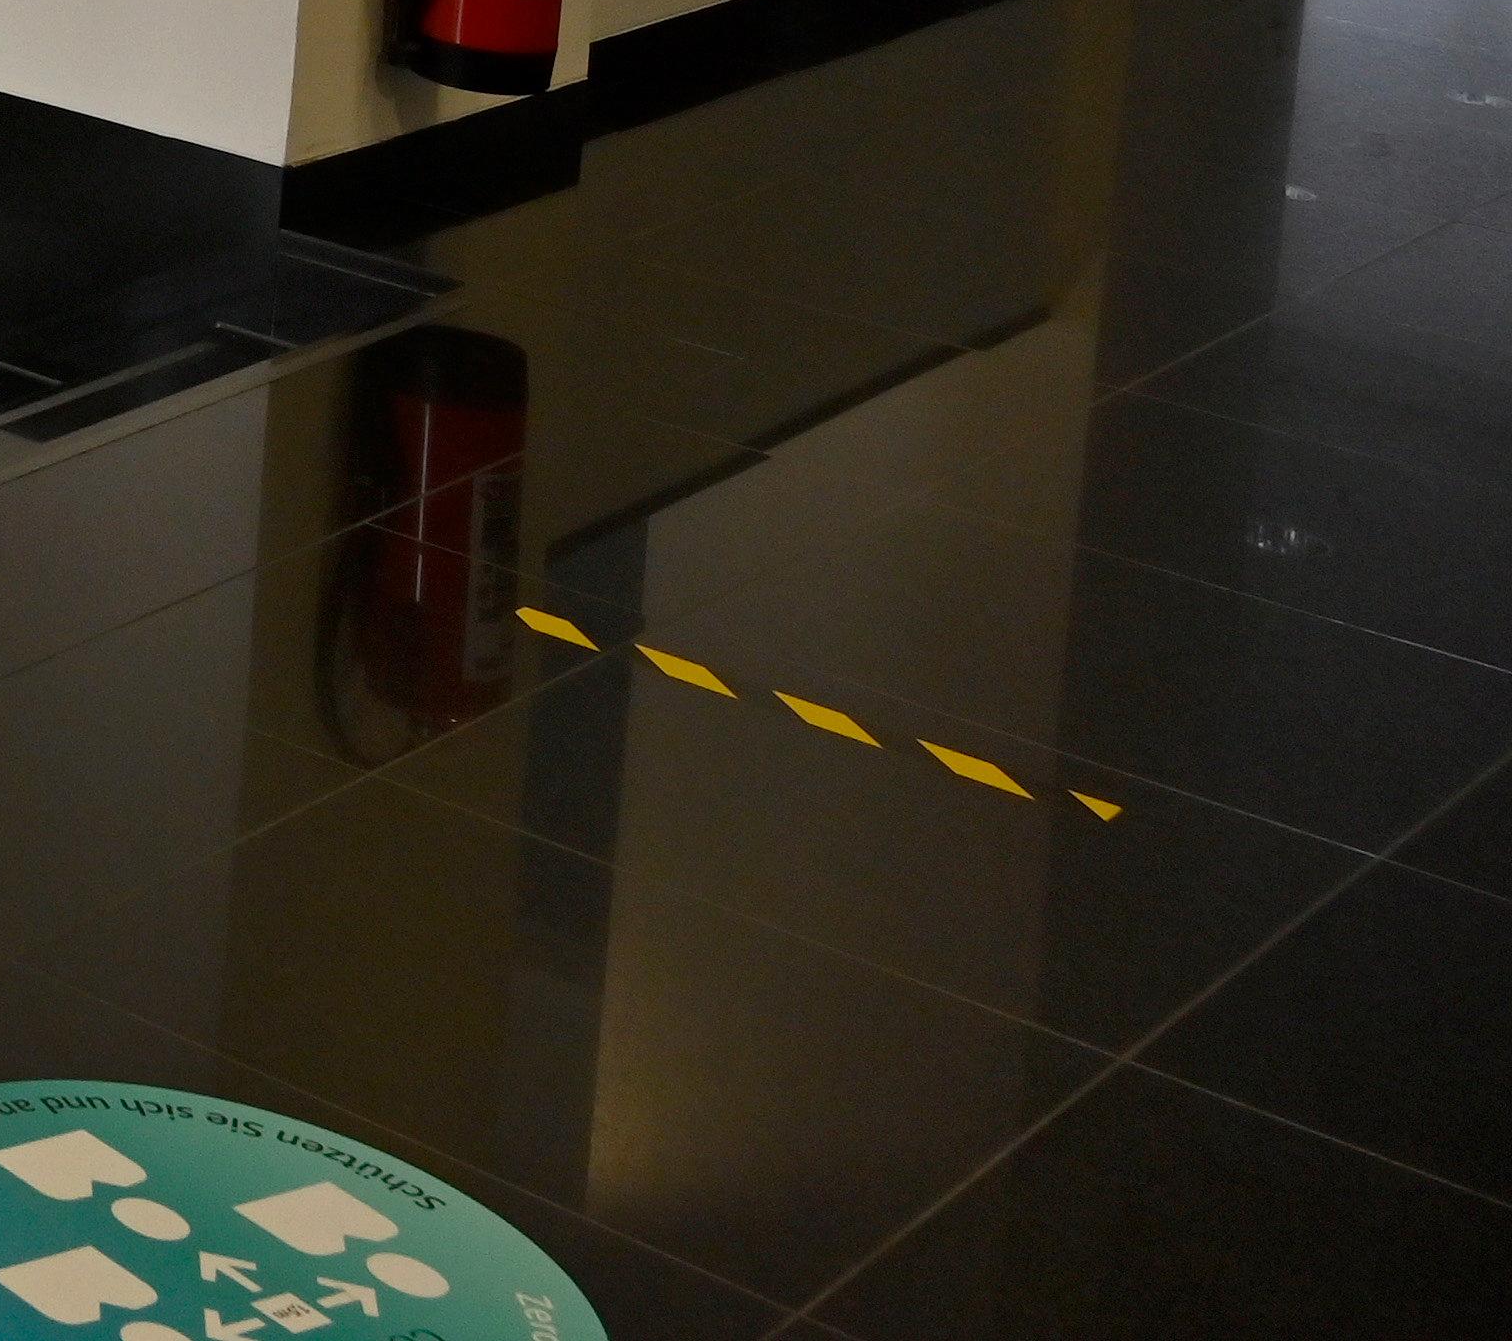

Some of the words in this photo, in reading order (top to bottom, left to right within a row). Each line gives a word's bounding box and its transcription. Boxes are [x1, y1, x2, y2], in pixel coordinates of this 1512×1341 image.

[41, 1095, 110, 1113] und
[120, 1097, 193, 1121] sich
[205, 1110, 264, 1139] Sie
[275, 1128, 447, 1212] Schützen
